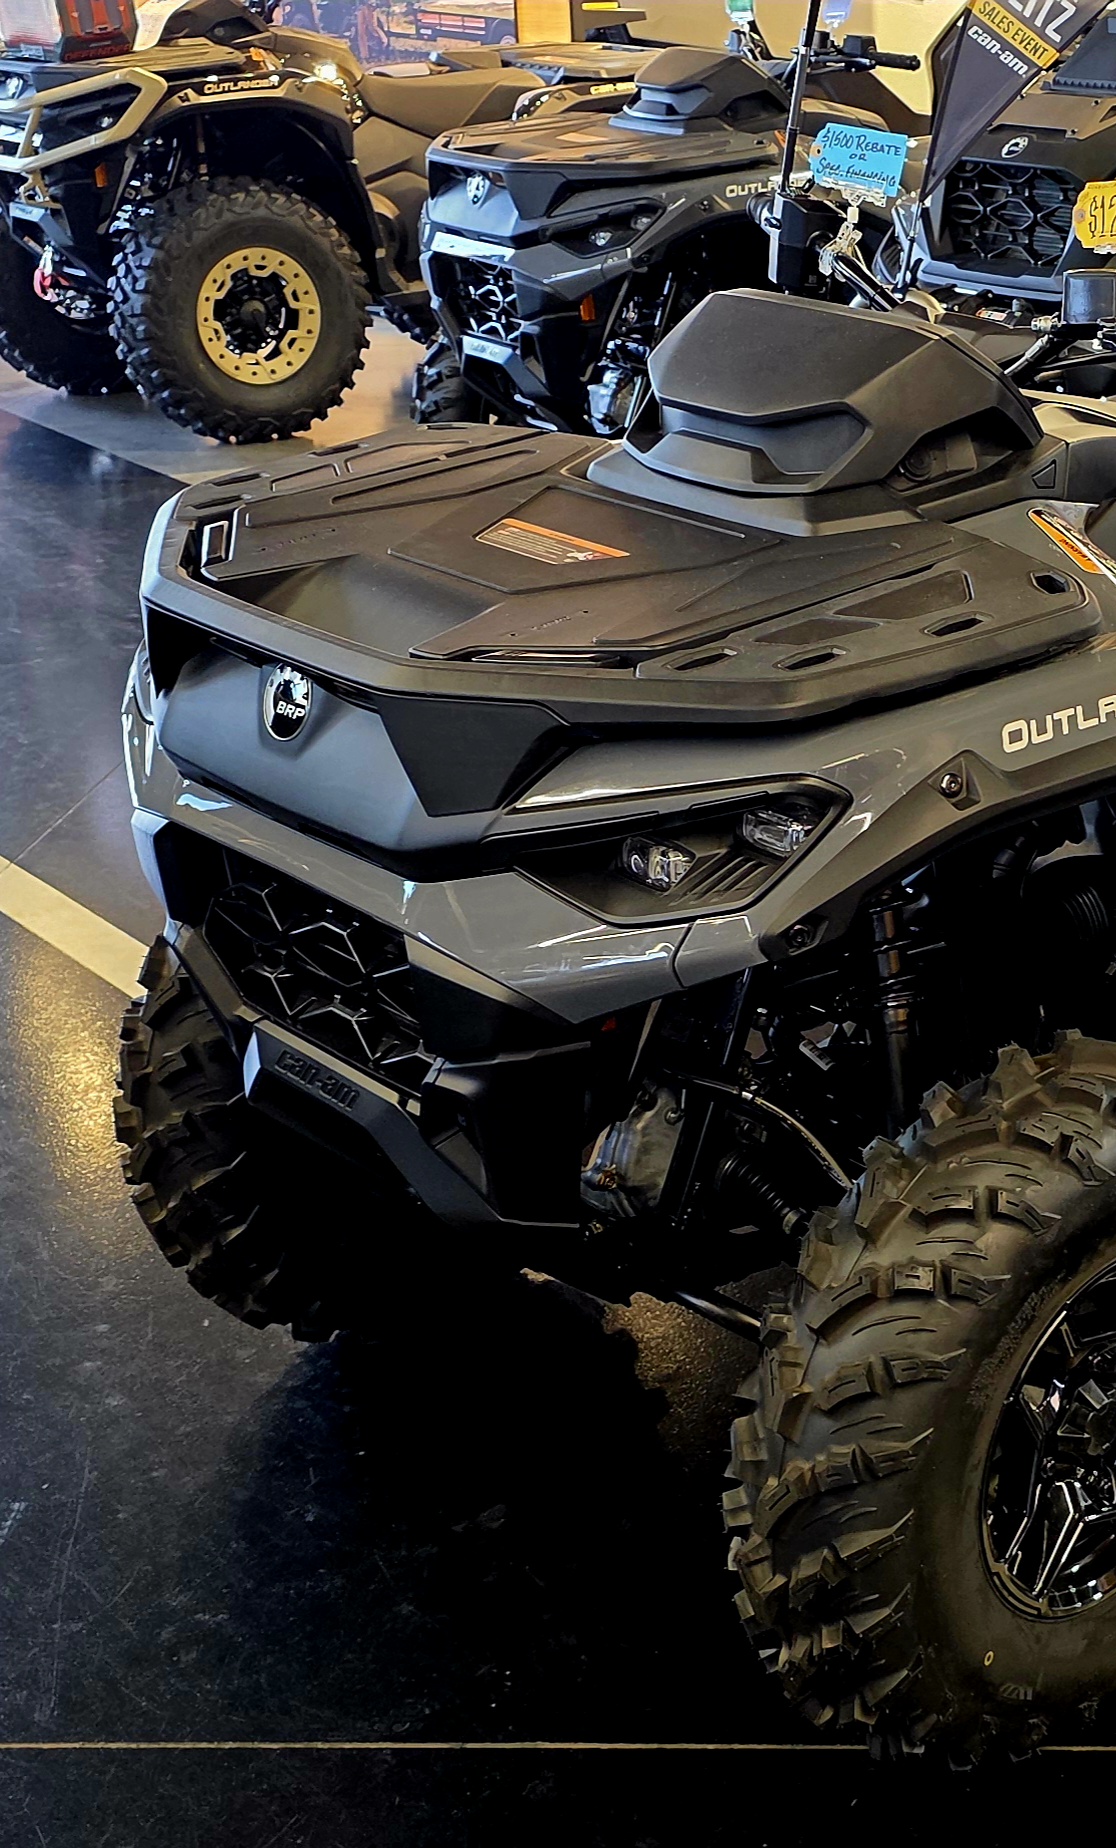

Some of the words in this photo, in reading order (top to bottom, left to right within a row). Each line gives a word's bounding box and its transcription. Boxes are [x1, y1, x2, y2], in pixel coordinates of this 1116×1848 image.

[967, 25, 1028, 76] can-am
[978, 1, 1015, 34] SALES
[1011, 28, 1049, 60] EVENT
[821, 127, 854, 149] $1500
[855, 135, 902, 156] REBATE
[276, 700, 306, 720] BRP
[274, 1049, 360, 1112] can-am
